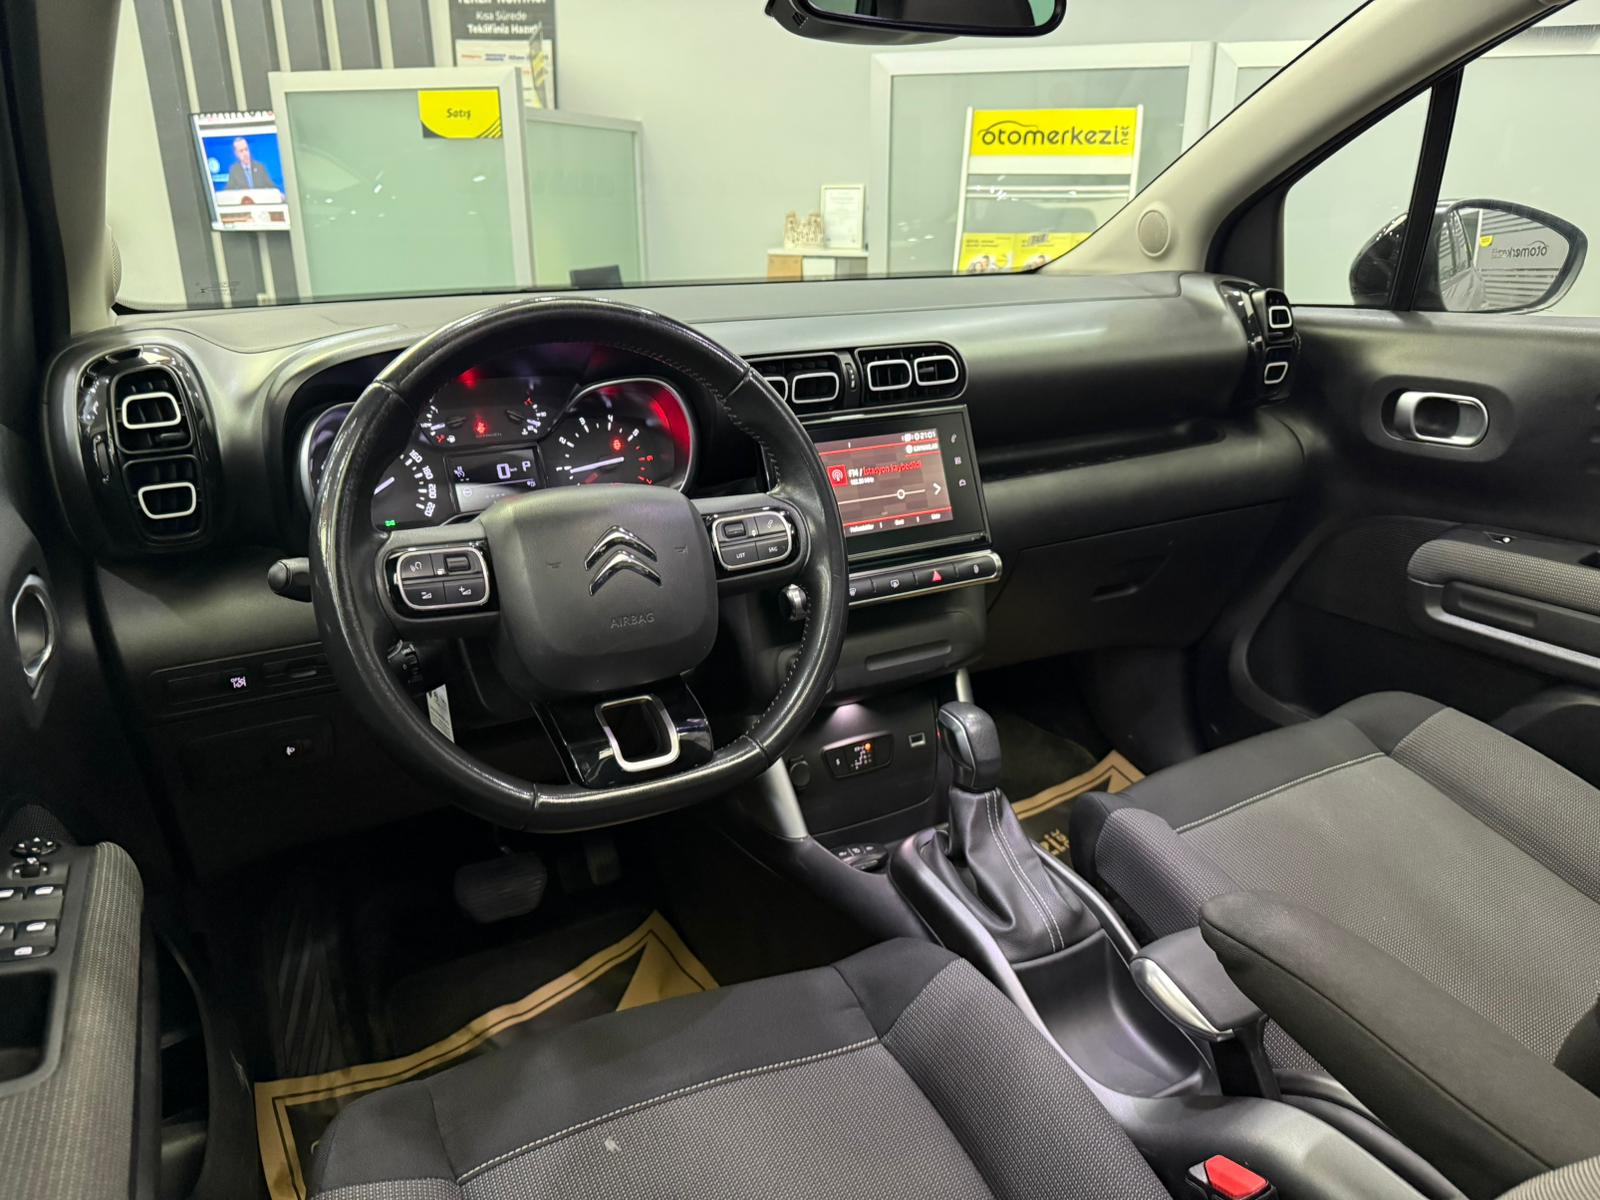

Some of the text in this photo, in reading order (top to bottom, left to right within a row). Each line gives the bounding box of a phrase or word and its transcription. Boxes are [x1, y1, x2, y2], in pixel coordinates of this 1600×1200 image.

[446, 107, 472, 120] Satış
[982, 126, 1120, 145] otomerkezi
[559, 436, 567, 445] 2
[422, 465, 434, 480] 180
[522, 460, 531, 472] P
[428, 483, 437, 499] 200
[424, 501, 436, 517] 220
[610, 612, 656, 629] AIRBAG
